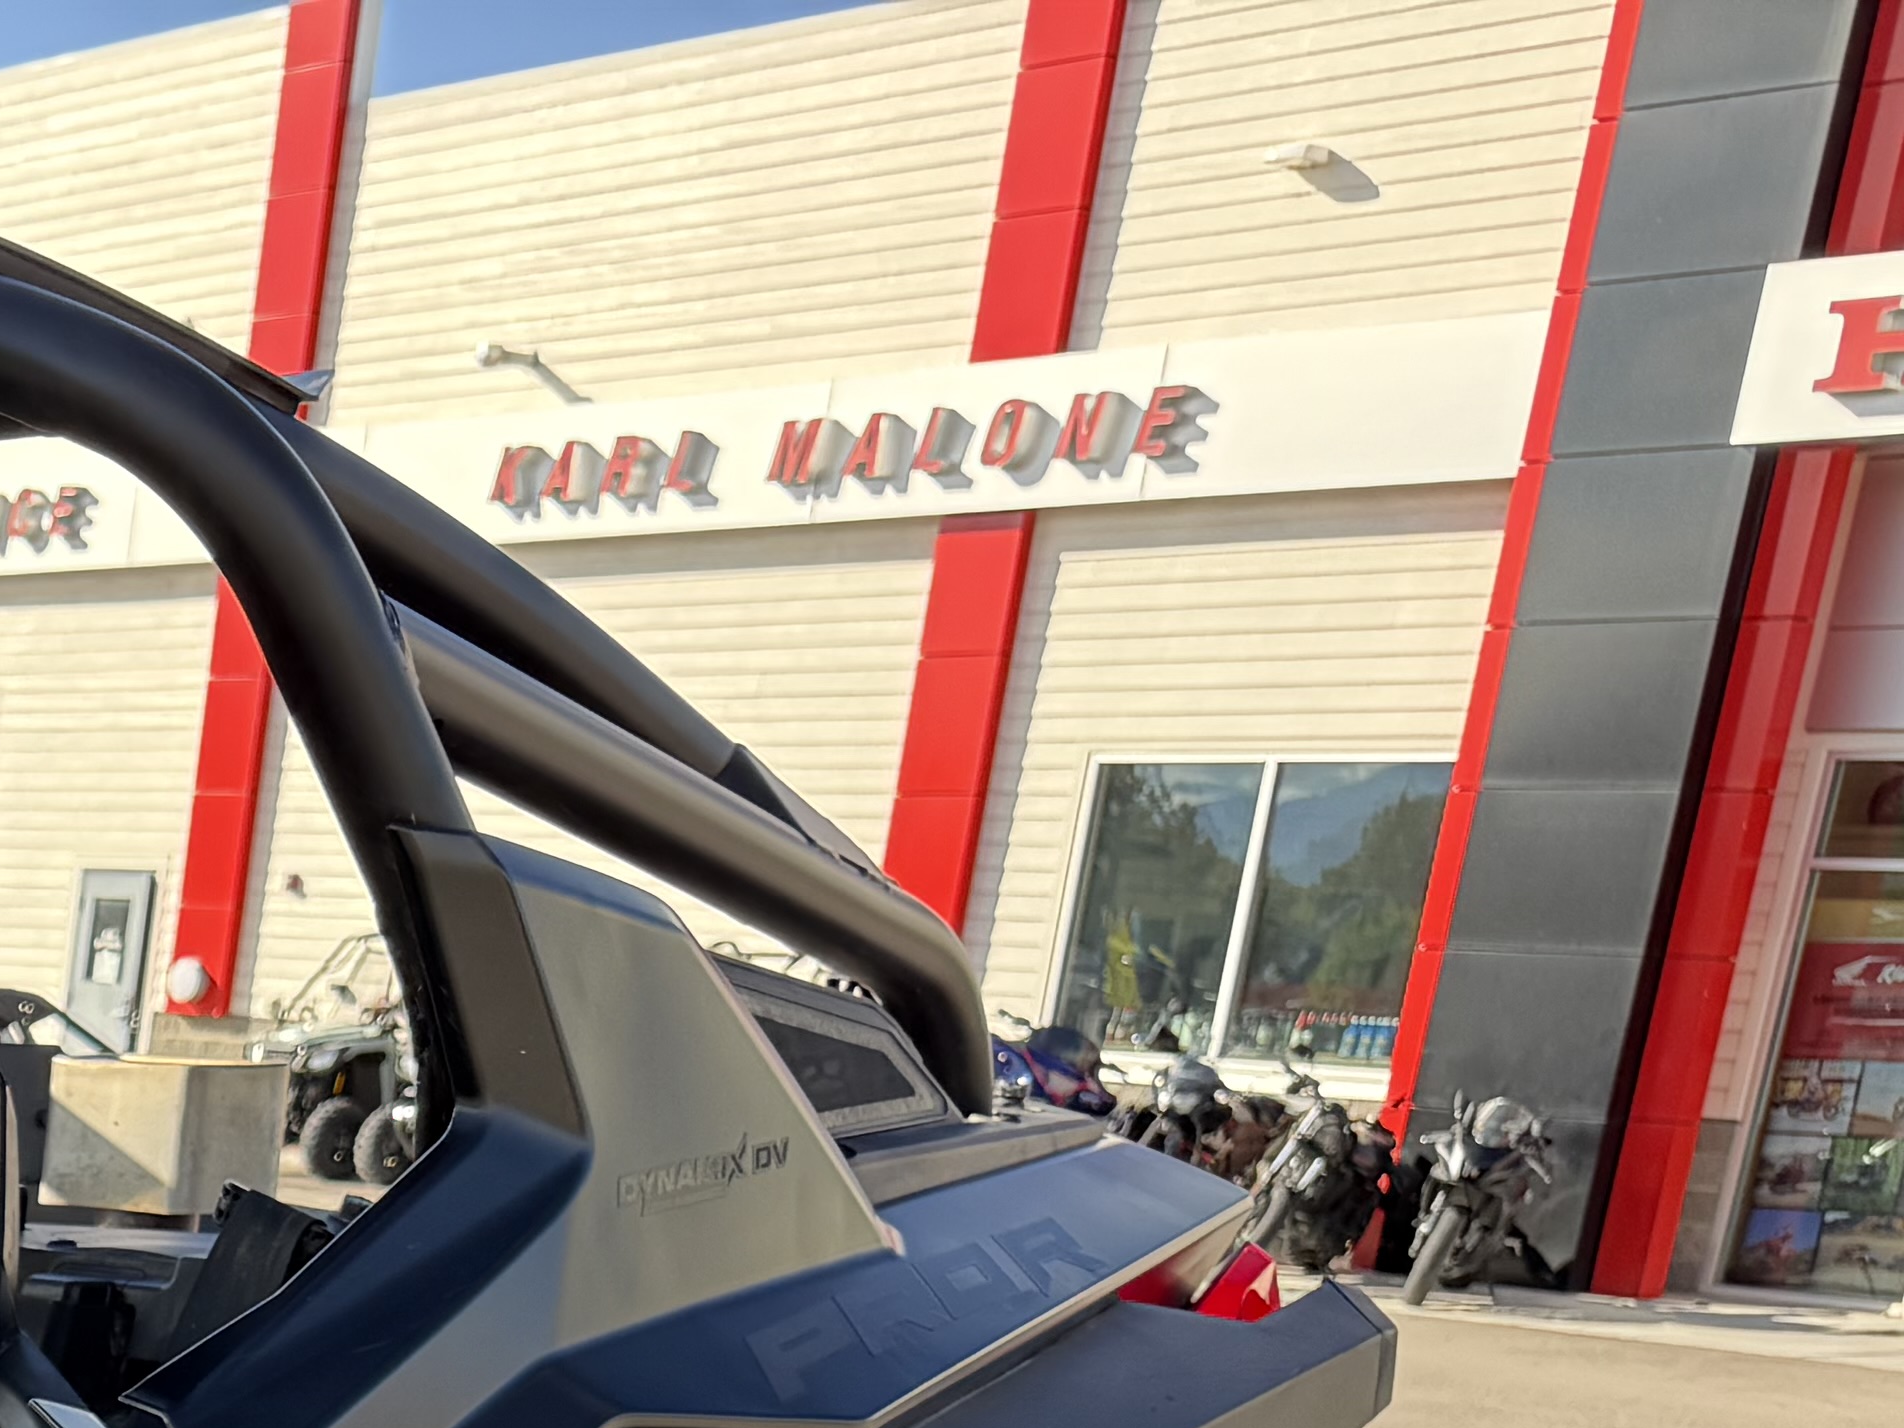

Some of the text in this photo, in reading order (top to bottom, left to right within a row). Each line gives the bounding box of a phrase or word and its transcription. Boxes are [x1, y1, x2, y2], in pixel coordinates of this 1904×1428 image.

[490, 386, 1204, 510] KARL MALONE
[753, 1136, 790, 1176] DV
